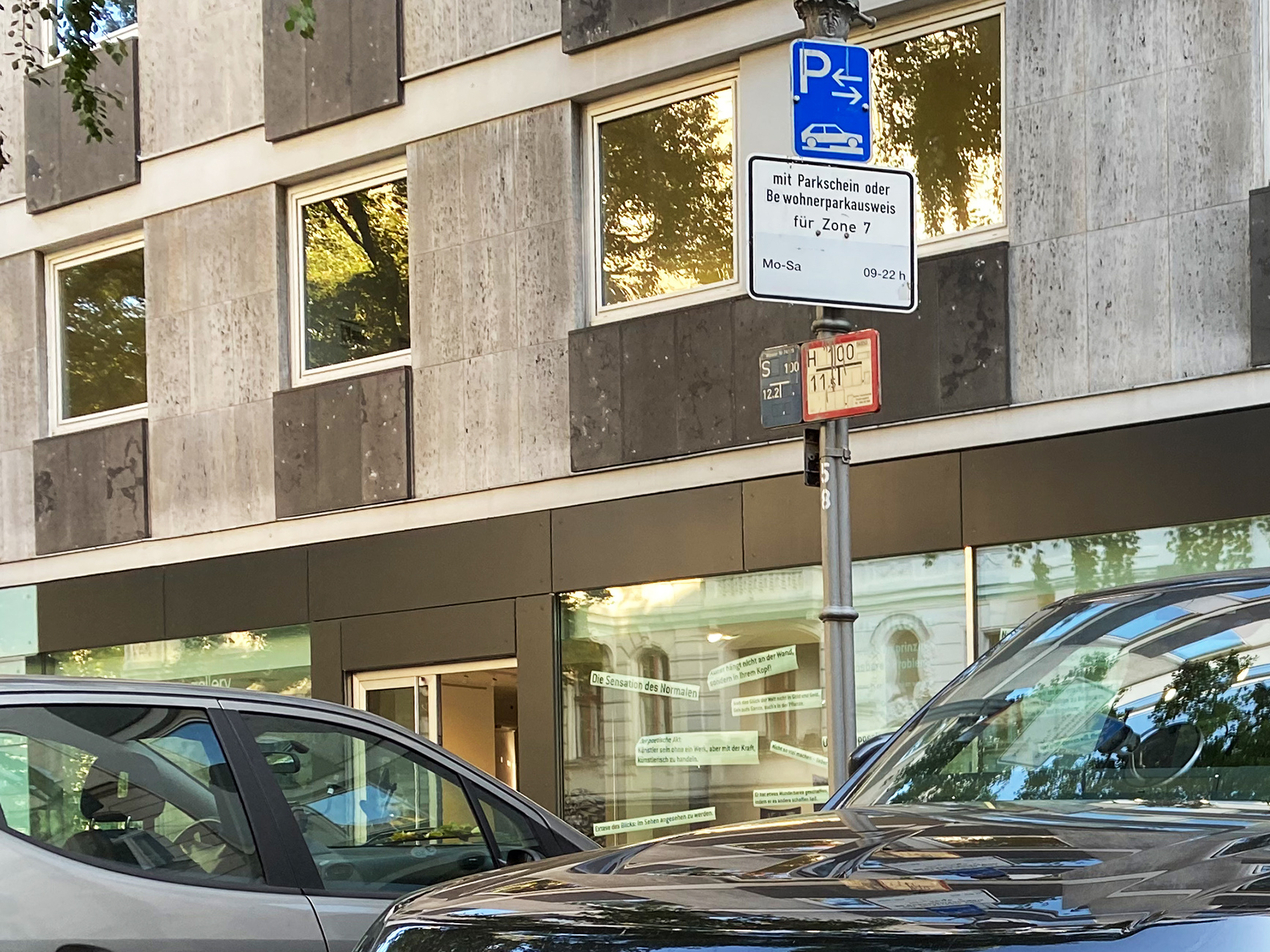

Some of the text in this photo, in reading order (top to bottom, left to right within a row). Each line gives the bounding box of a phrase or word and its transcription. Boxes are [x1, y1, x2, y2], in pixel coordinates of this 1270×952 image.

[799, 49, 832, 94] P
[773, 173, 890, 196] mit Parkschein oder
[794, 216, 870, 234] für Zone 7
[762, 258, 906, 280] Mo-Sa 09-22 h
[808, 350, 816, 367] H
[829, 344, 854, 366] 100
[762, 360, 770, 378] S
[762, 387, 779, 400] 12.2
[742, 658, 758, 667] nicht
[592, 674, 698, 698] Die Sensation des Normalen
